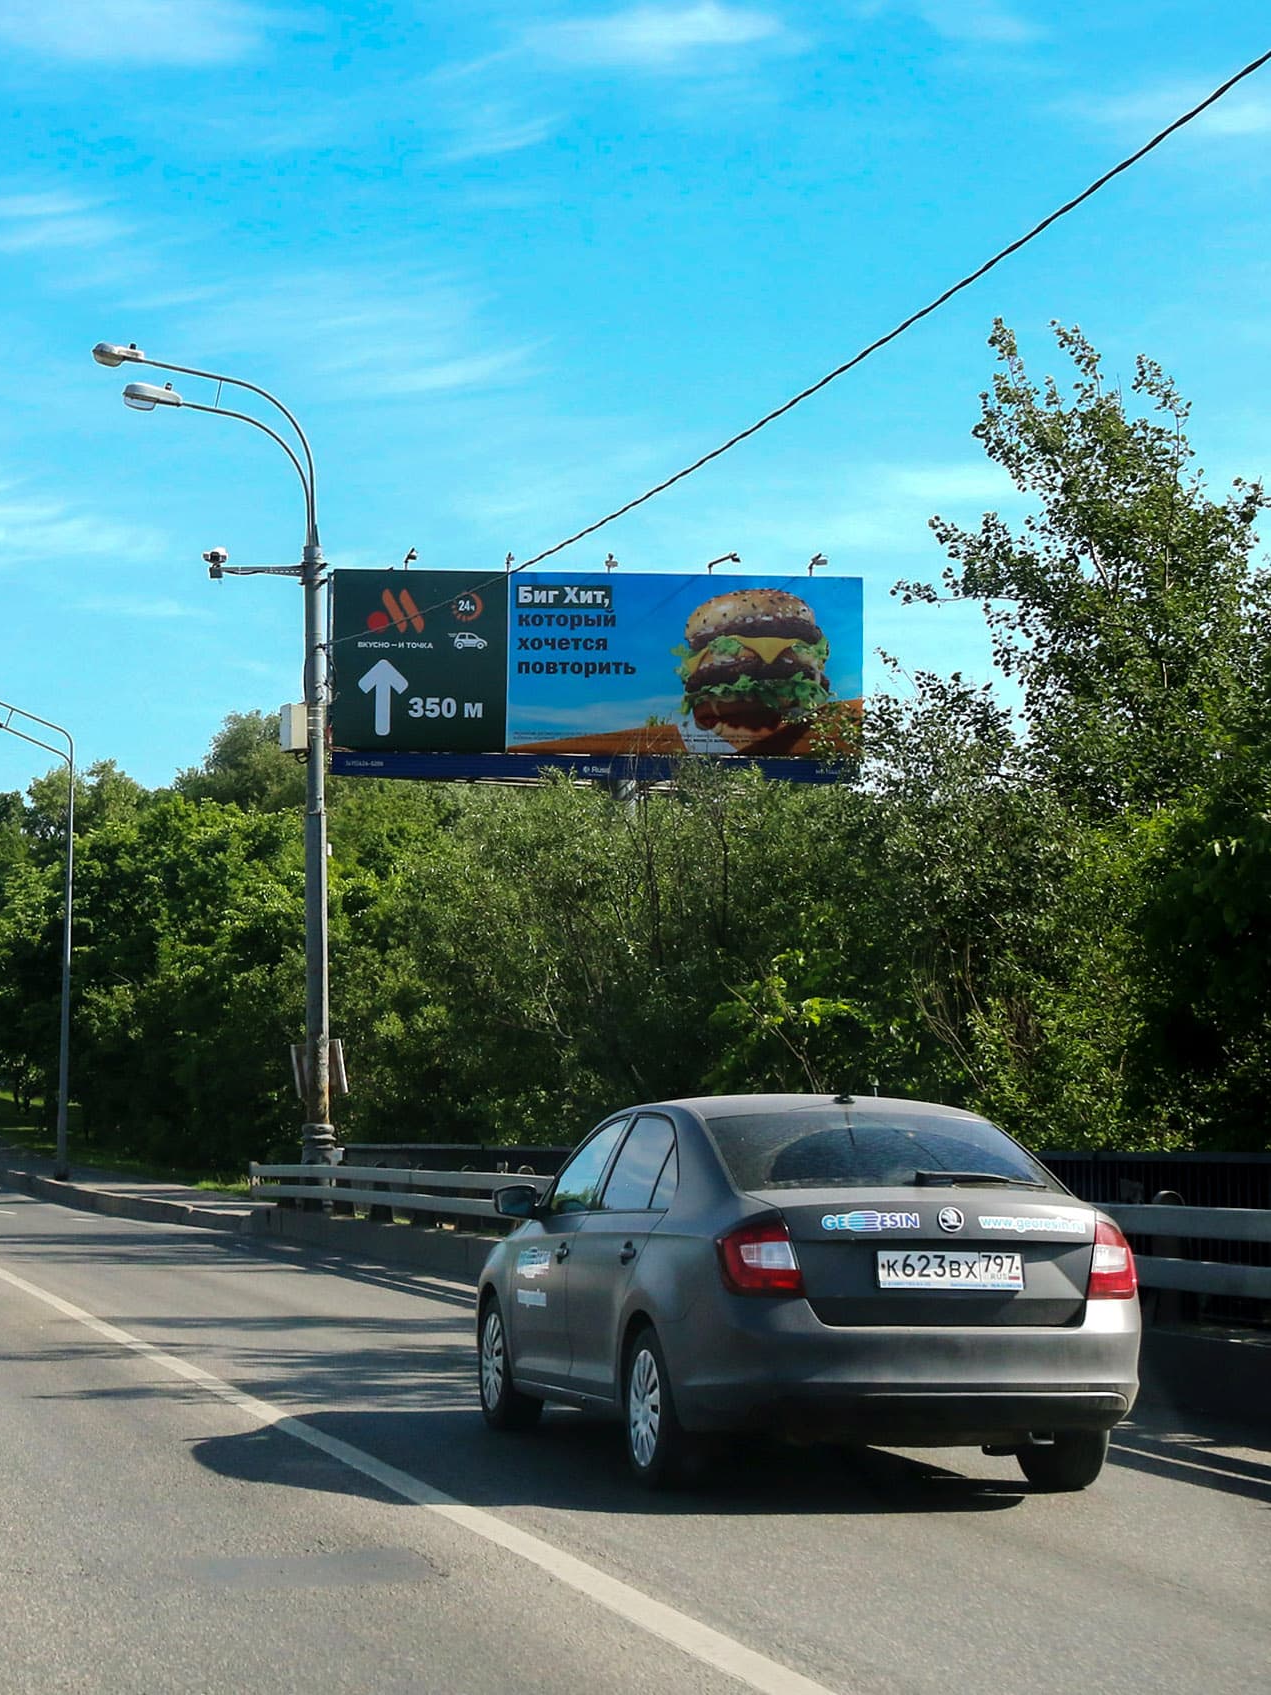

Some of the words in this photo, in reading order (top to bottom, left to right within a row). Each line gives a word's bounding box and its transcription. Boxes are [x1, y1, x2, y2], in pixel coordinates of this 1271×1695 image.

[518, 586, 559, 603] Биг
[563, 586, 610, 607] Хит,
[517, 608, 616, 630] который
[357, 641, 390, 649] ВКУСНО
[406, 641, 433, 649] ТОЧКА
[517, 637, 608, 651] хочется
[517, 661, 637, 678] повторить
[408, 697, 457, 718] 350
[886, 1254, 978, 1279] К623ВХ
[981, 1255, 1016, 1273] 797
